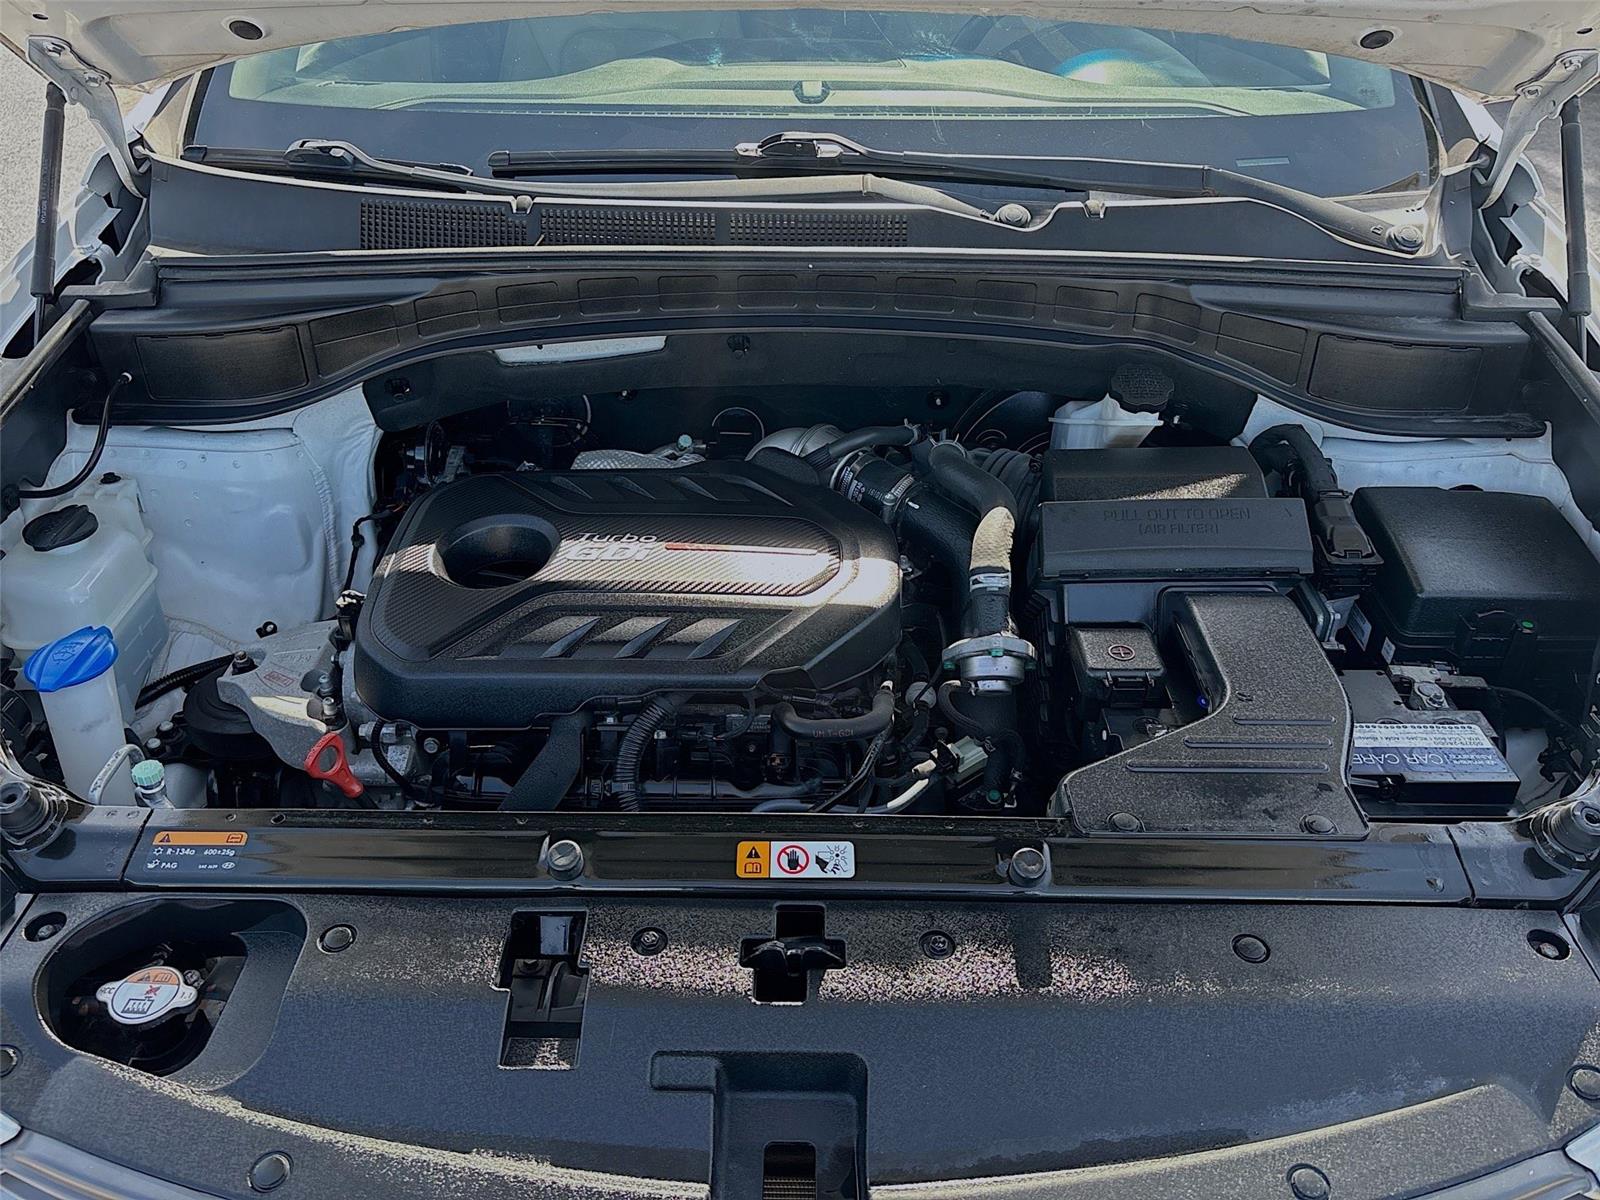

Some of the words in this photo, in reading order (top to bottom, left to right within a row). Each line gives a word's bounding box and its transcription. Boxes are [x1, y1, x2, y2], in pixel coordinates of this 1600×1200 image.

[1103, 509, 1138, 521] PULL
[1148, 508, 1177, 521] OUT
[1186, 508, 1204, 520] TO
[1208, 507, 1251, 520] OPEN
[578, 533, 658, 544] Turbo
[1403, 753, 1443, 765] CAR
[166, 847, 196, 856] R-134a
